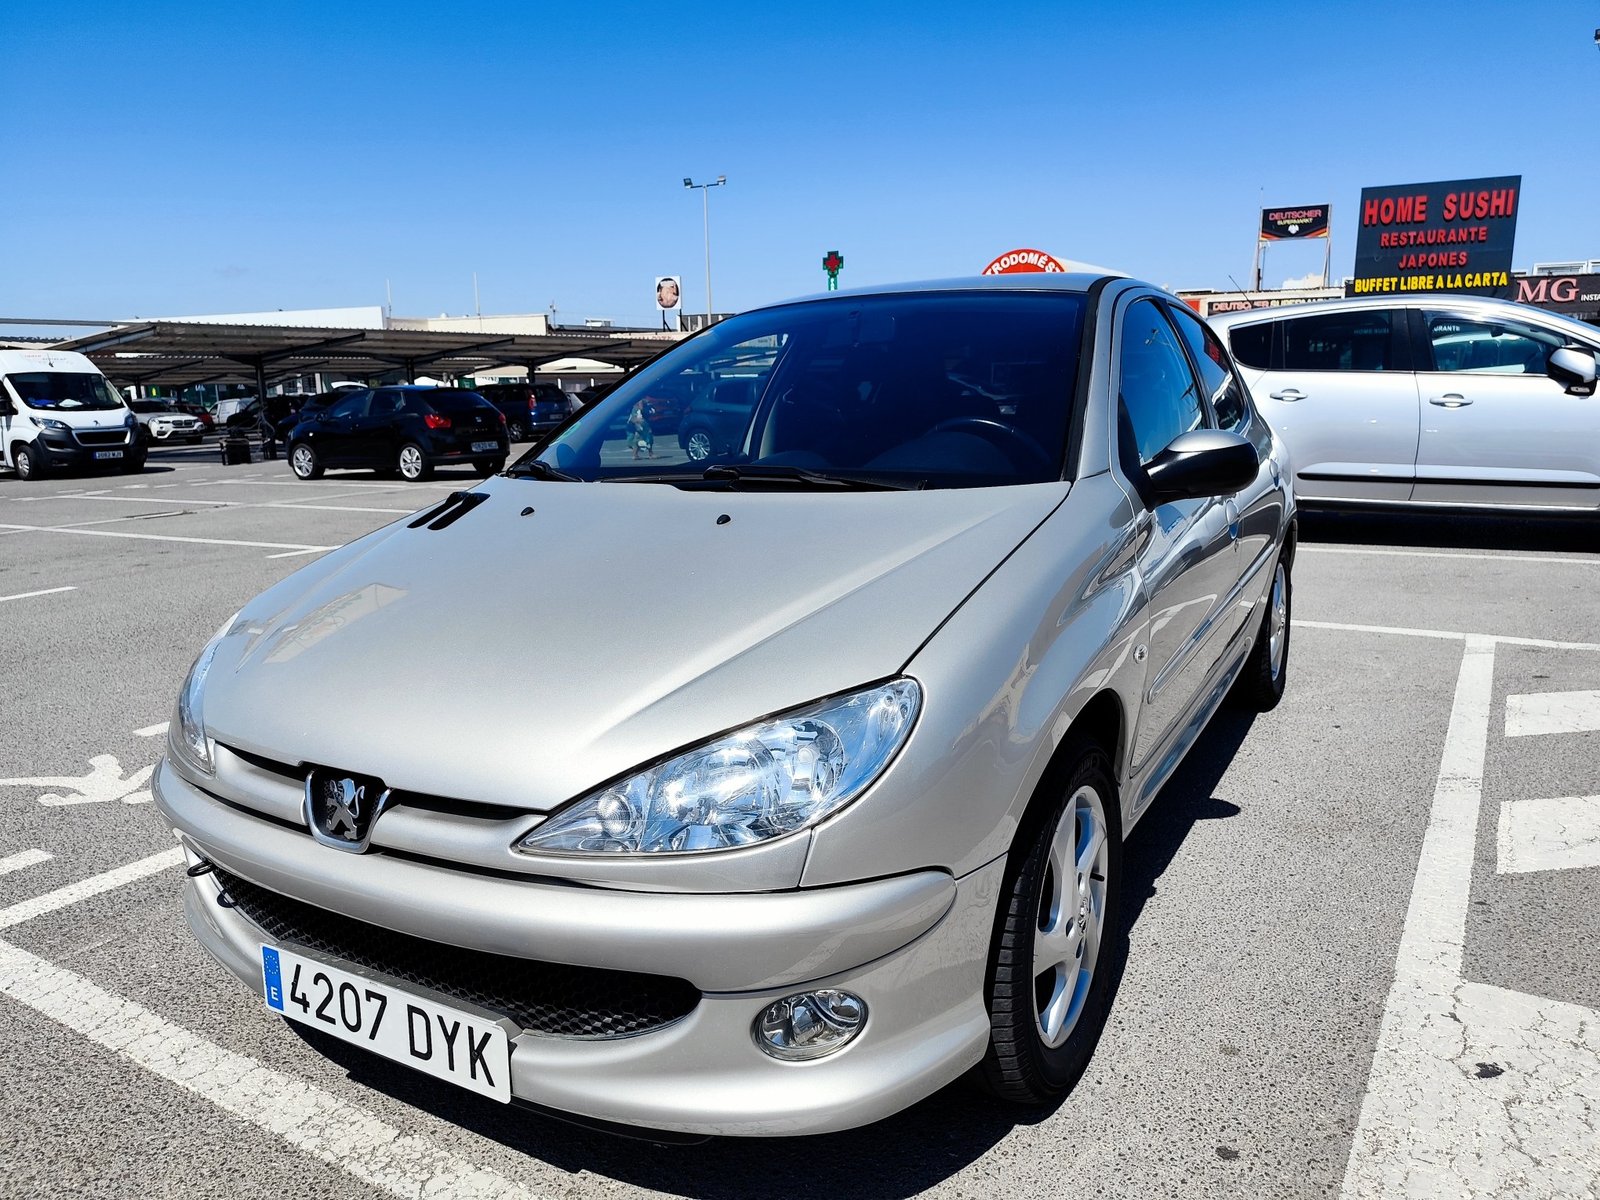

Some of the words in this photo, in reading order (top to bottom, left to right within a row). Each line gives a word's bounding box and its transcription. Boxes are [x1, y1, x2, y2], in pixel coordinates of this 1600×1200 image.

[1269, 209, 1322, 220] DEUTSCHER
[1363, 195, 1428, 225] HOME
[1443, 188, 1515, 220] SUSHI
[1380, 226, 1488, 248] RESTAURANTE
[1398, 251, 1468, 269] JAPONES
[1354, 277, 1398, 293] BUFFET
[1400, 275, 1434, 291] LIBRE
[1435, 274, 1444, 289] A
[1446, 274, 1462, 288] LA
[1464, 272, 1508, 287] CARTA
[1515, 277, 1580, 302] MG
[270, 985, 278, 1001] E
[290, 963, 387, 1041] 4207
[407, 1003, 495, 1088] DYK
